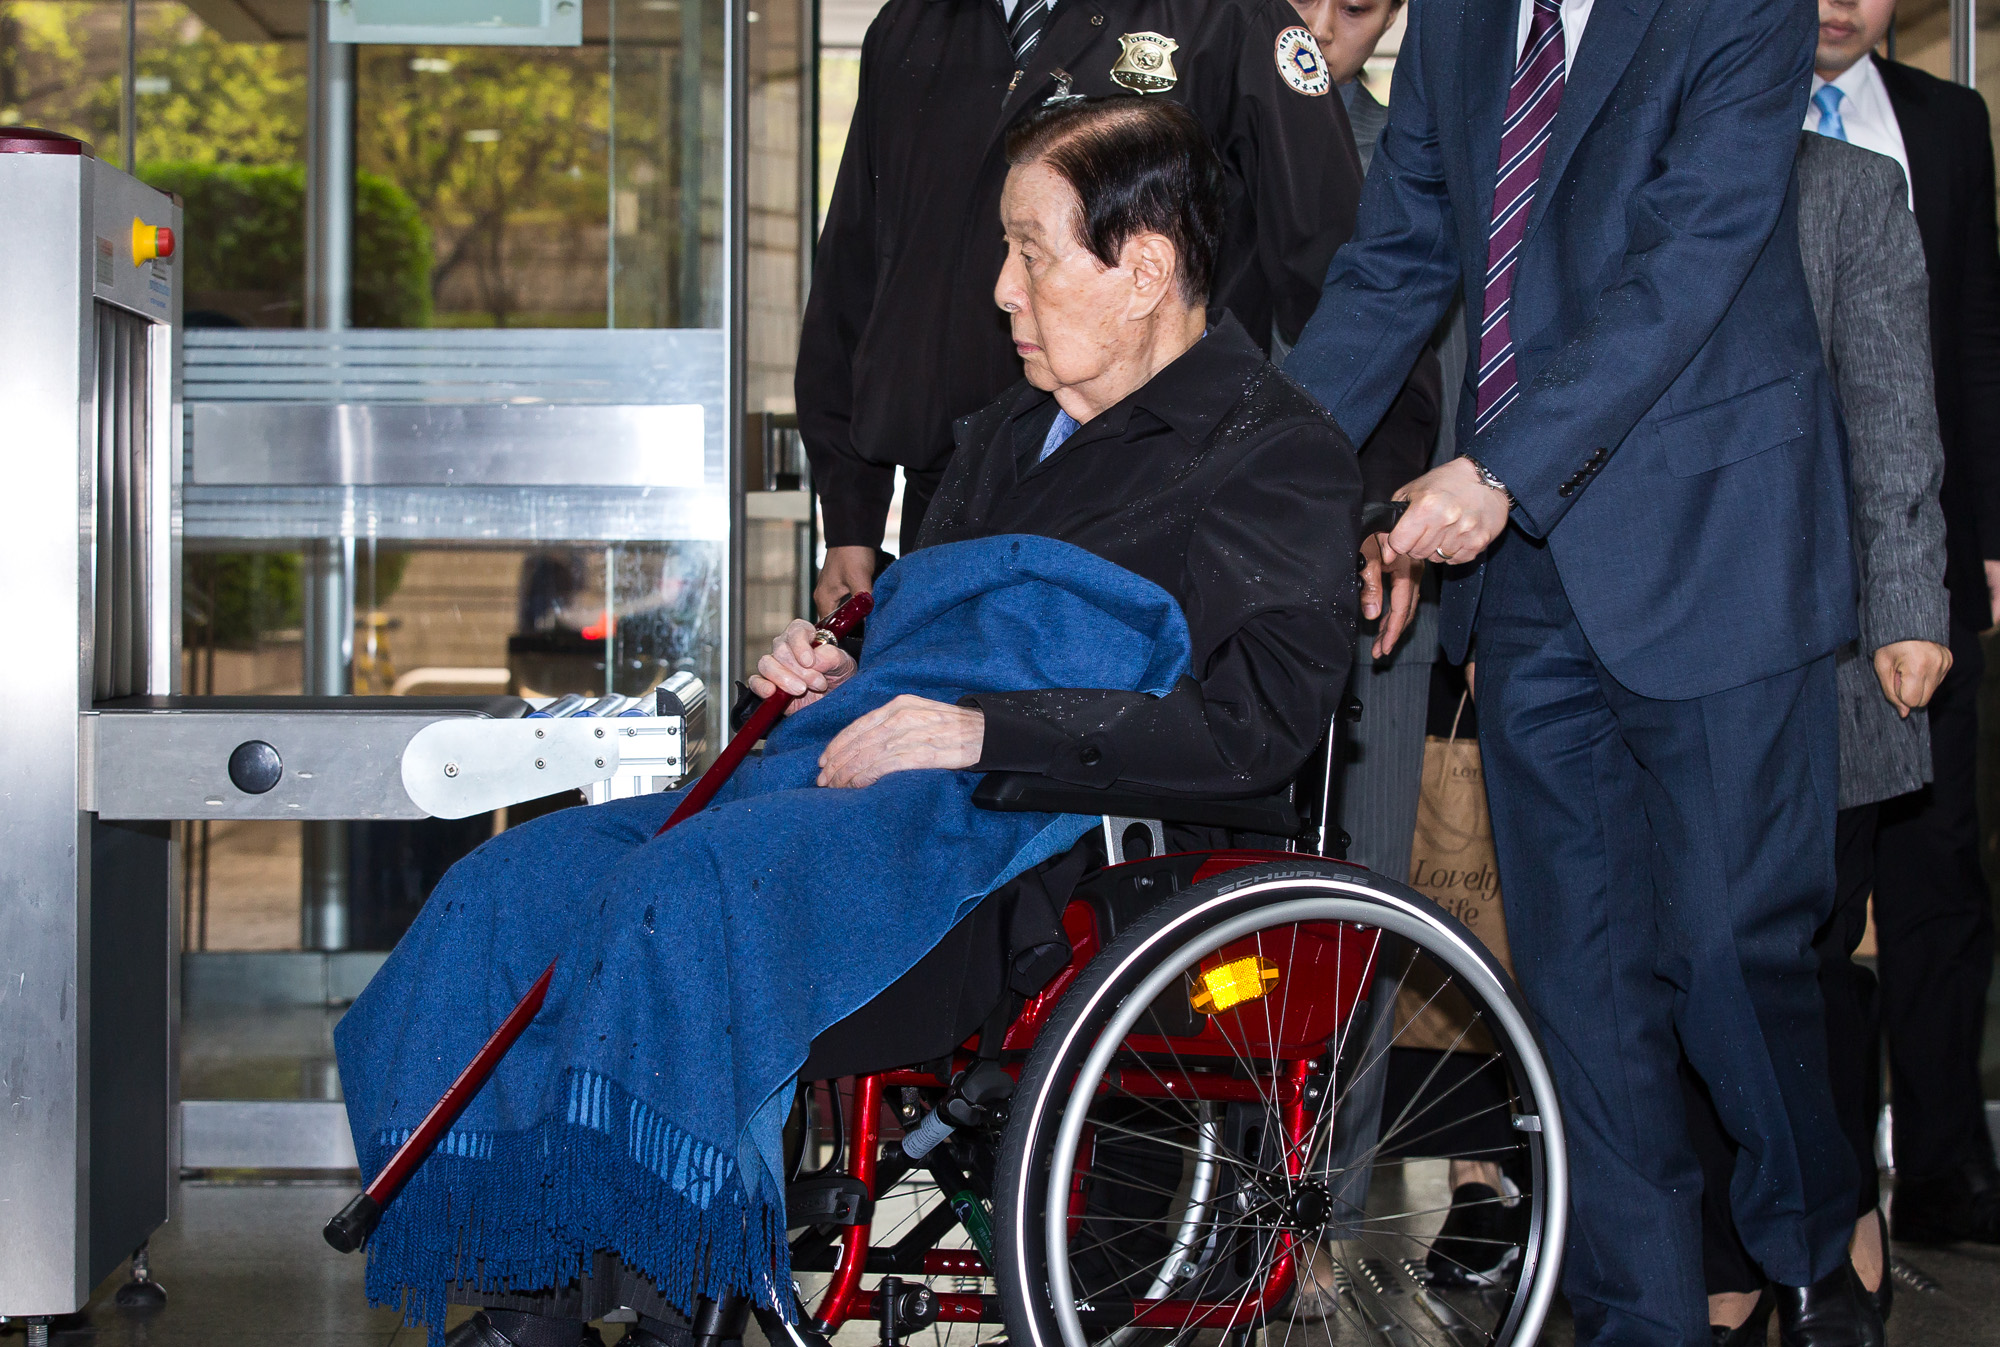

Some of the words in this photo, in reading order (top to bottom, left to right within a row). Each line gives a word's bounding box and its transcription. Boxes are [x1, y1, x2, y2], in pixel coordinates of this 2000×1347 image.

[1217, 870, 1369, 896] SCHWALBE
[1412, 859, 1500, 901] Lovely
[1433, 896, 1479, 927] ife
